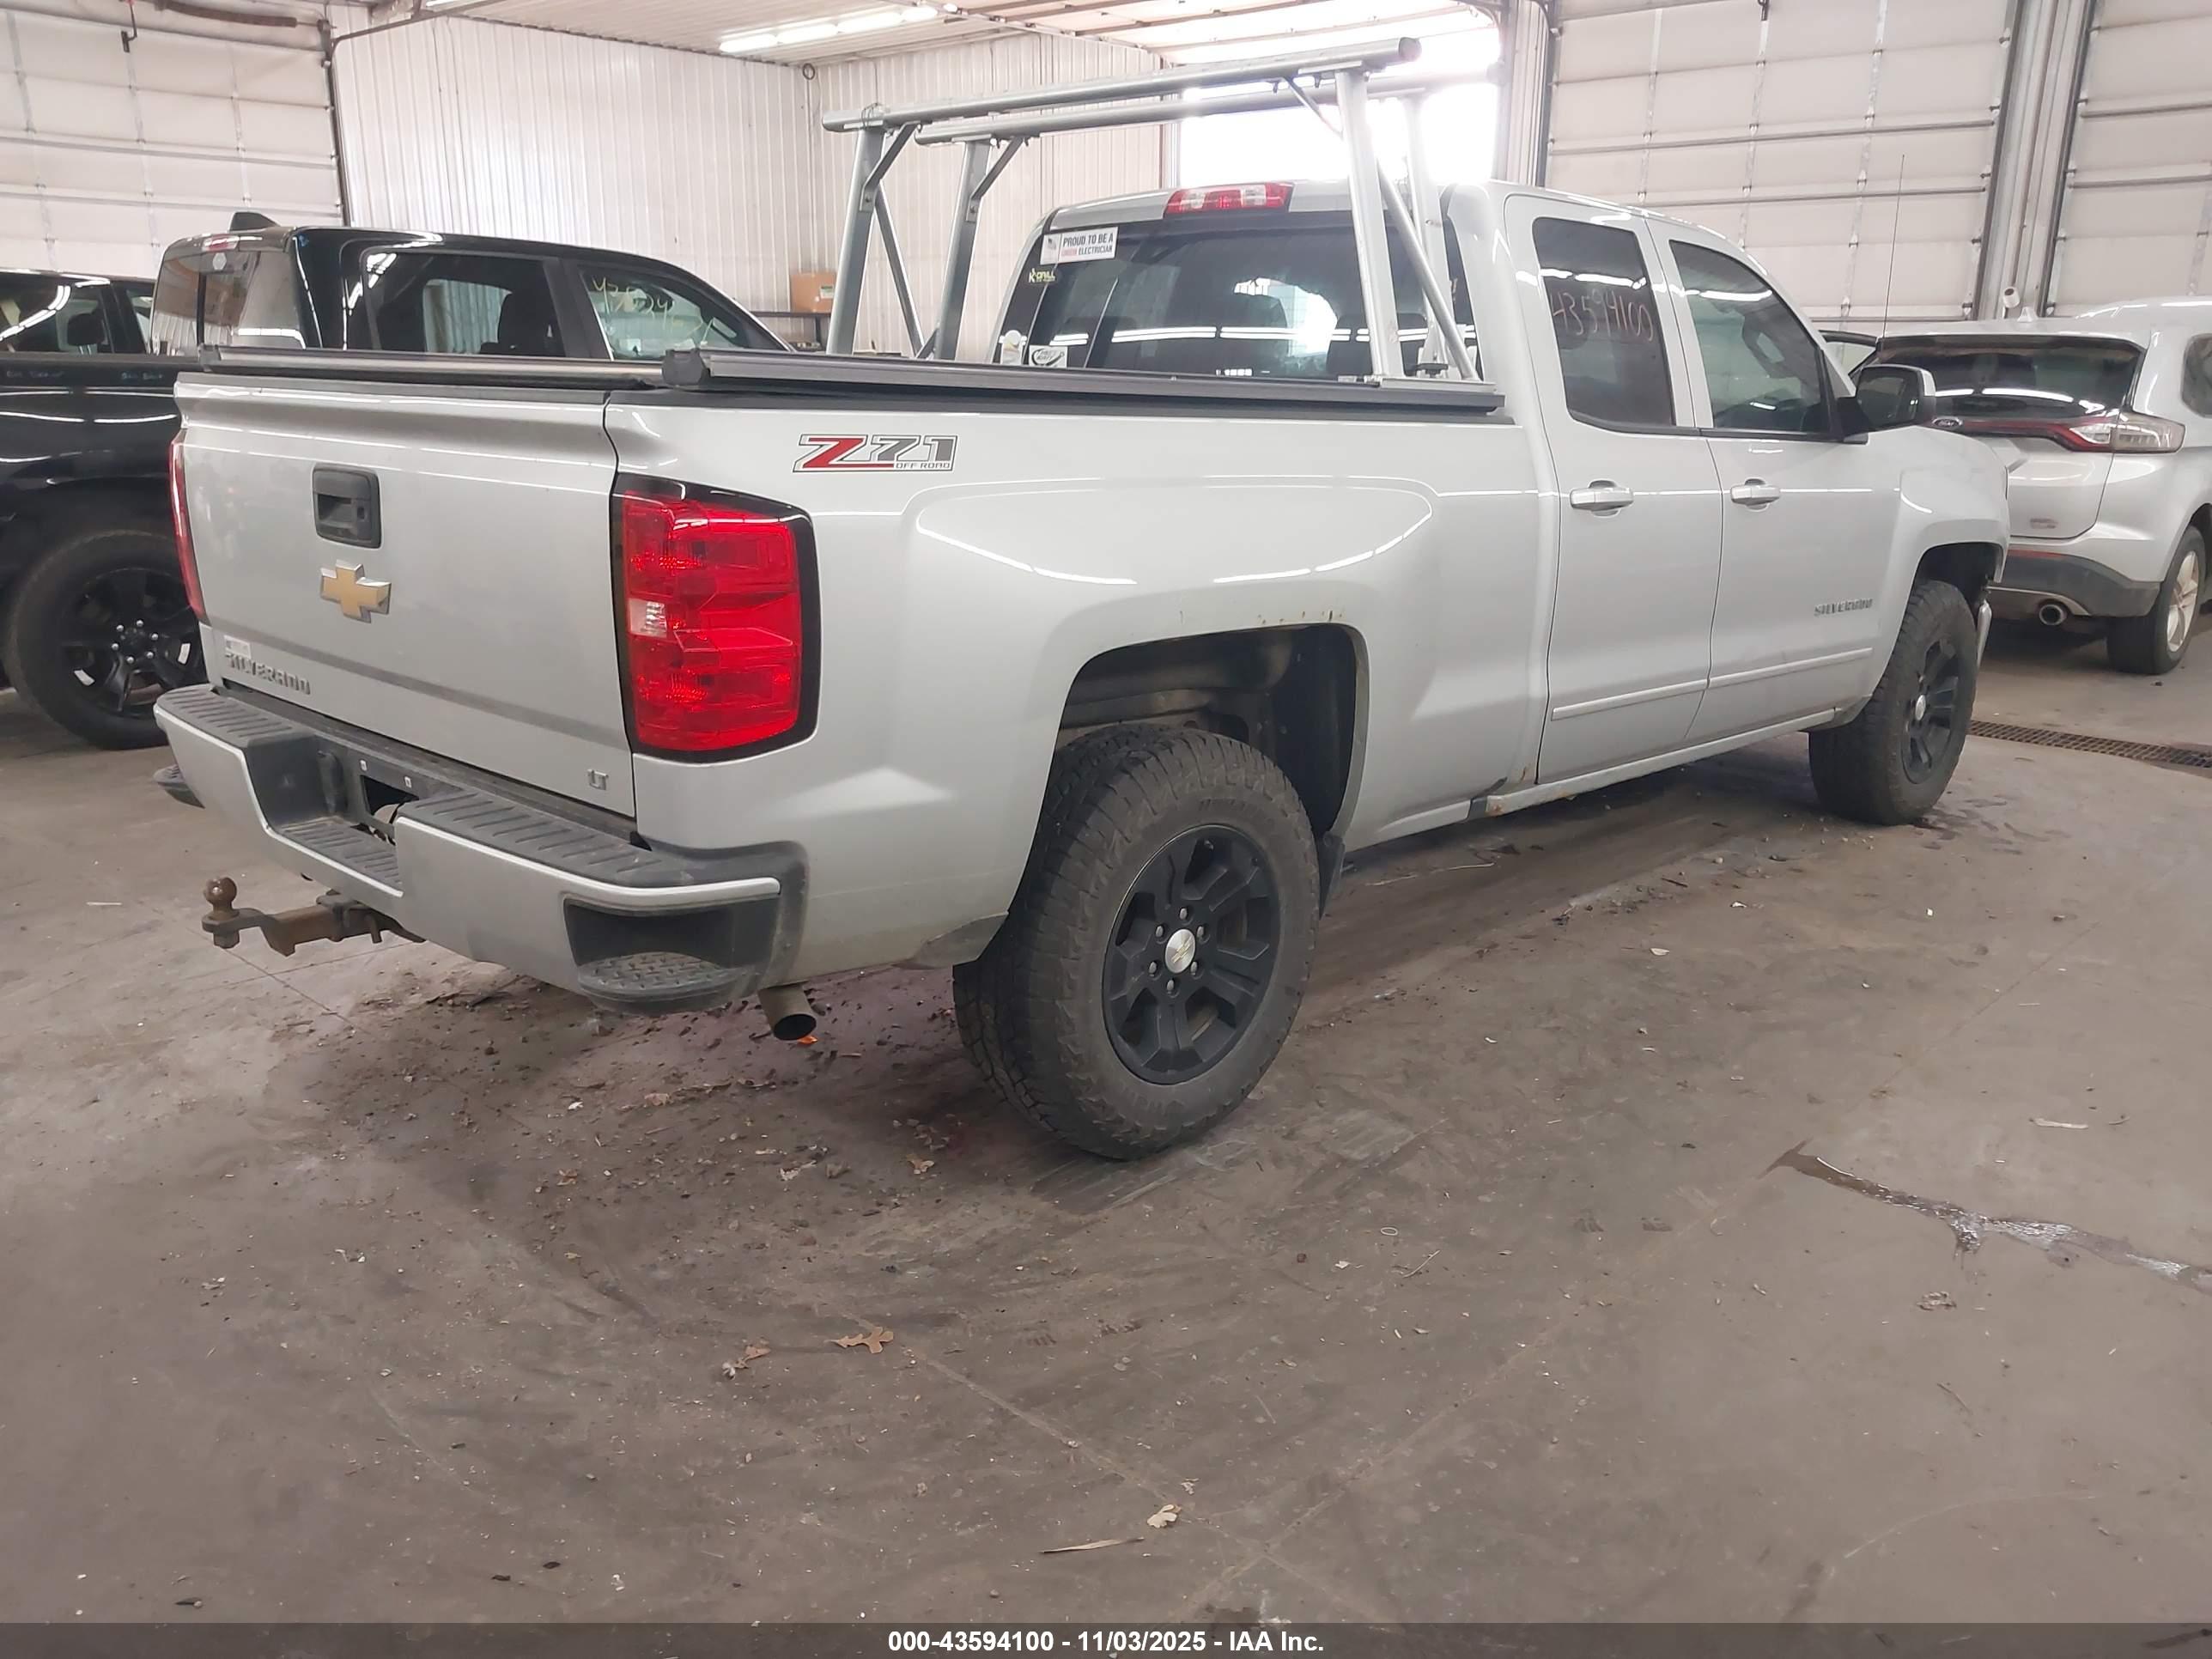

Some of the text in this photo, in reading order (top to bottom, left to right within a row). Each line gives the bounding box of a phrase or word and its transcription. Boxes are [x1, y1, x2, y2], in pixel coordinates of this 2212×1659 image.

[1062, 232, 1115, 248] PROUD TO BE A
[1079, 245, 1114, 256] ELECTRICIAN
[793, 434, 958, 472] Z71
[587, 769, 609, 791] LT
